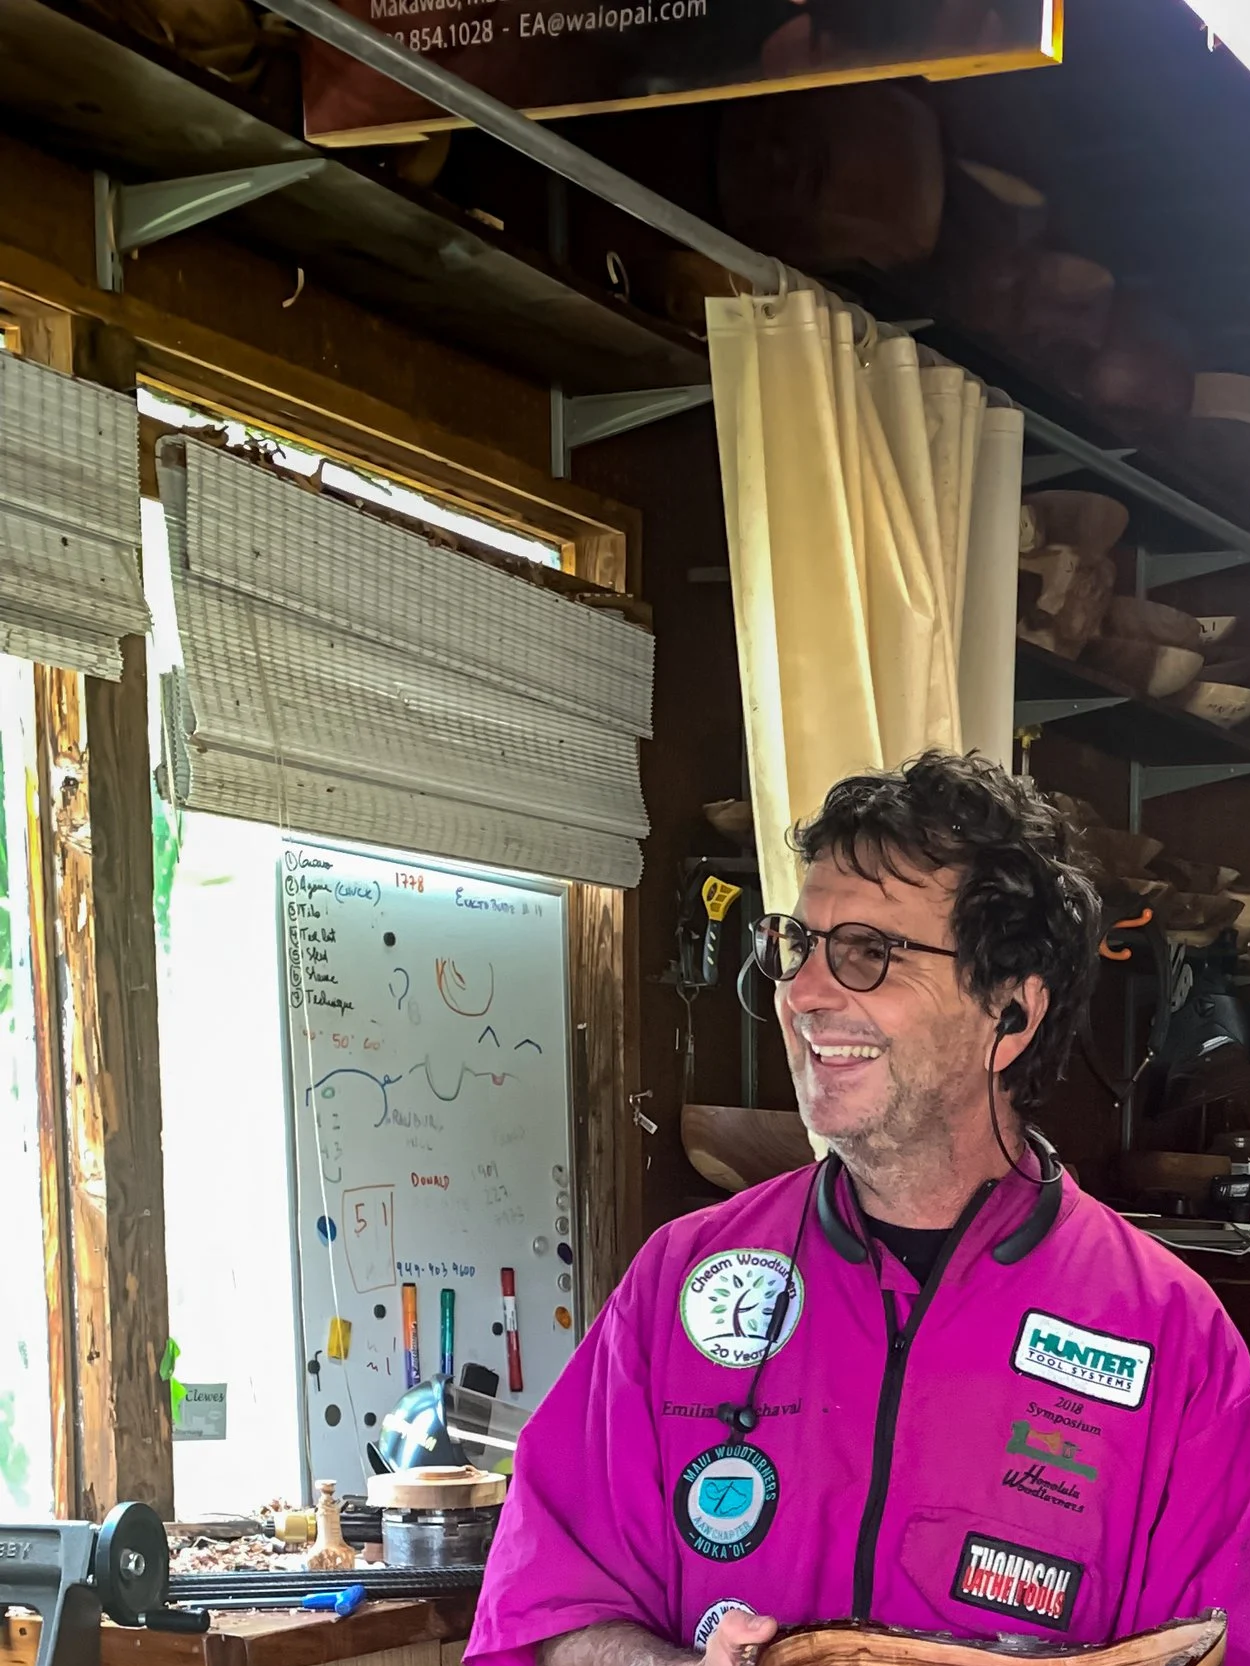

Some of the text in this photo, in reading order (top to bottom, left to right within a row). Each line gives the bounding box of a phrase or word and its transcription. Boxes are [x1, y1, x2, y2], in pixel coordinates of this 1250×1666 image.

[396, 872, 424, 893] 1778
[411, 1172, 449, 1191] DONALD
[691, 1259, 733, 1293] Cheam
[710, 1344, 767, 1361] 20 Year
[1029, 1328, 1136, 1378] HUNTER
[1028, 1350, 1132, 1389] TOOL SYSTEMS
[756, 1398, 802, 1418] chaval
[1027, 1401, 1101, 1435] Symposium
[1054, 1396, 1084, 1415] 2018
[683, 1445, 776, 1500] MAUI WOODTURNERS
[963, 1544, 1071, 1619] THOMPSON
[697, 1611, 720, 1644] TAUPO
